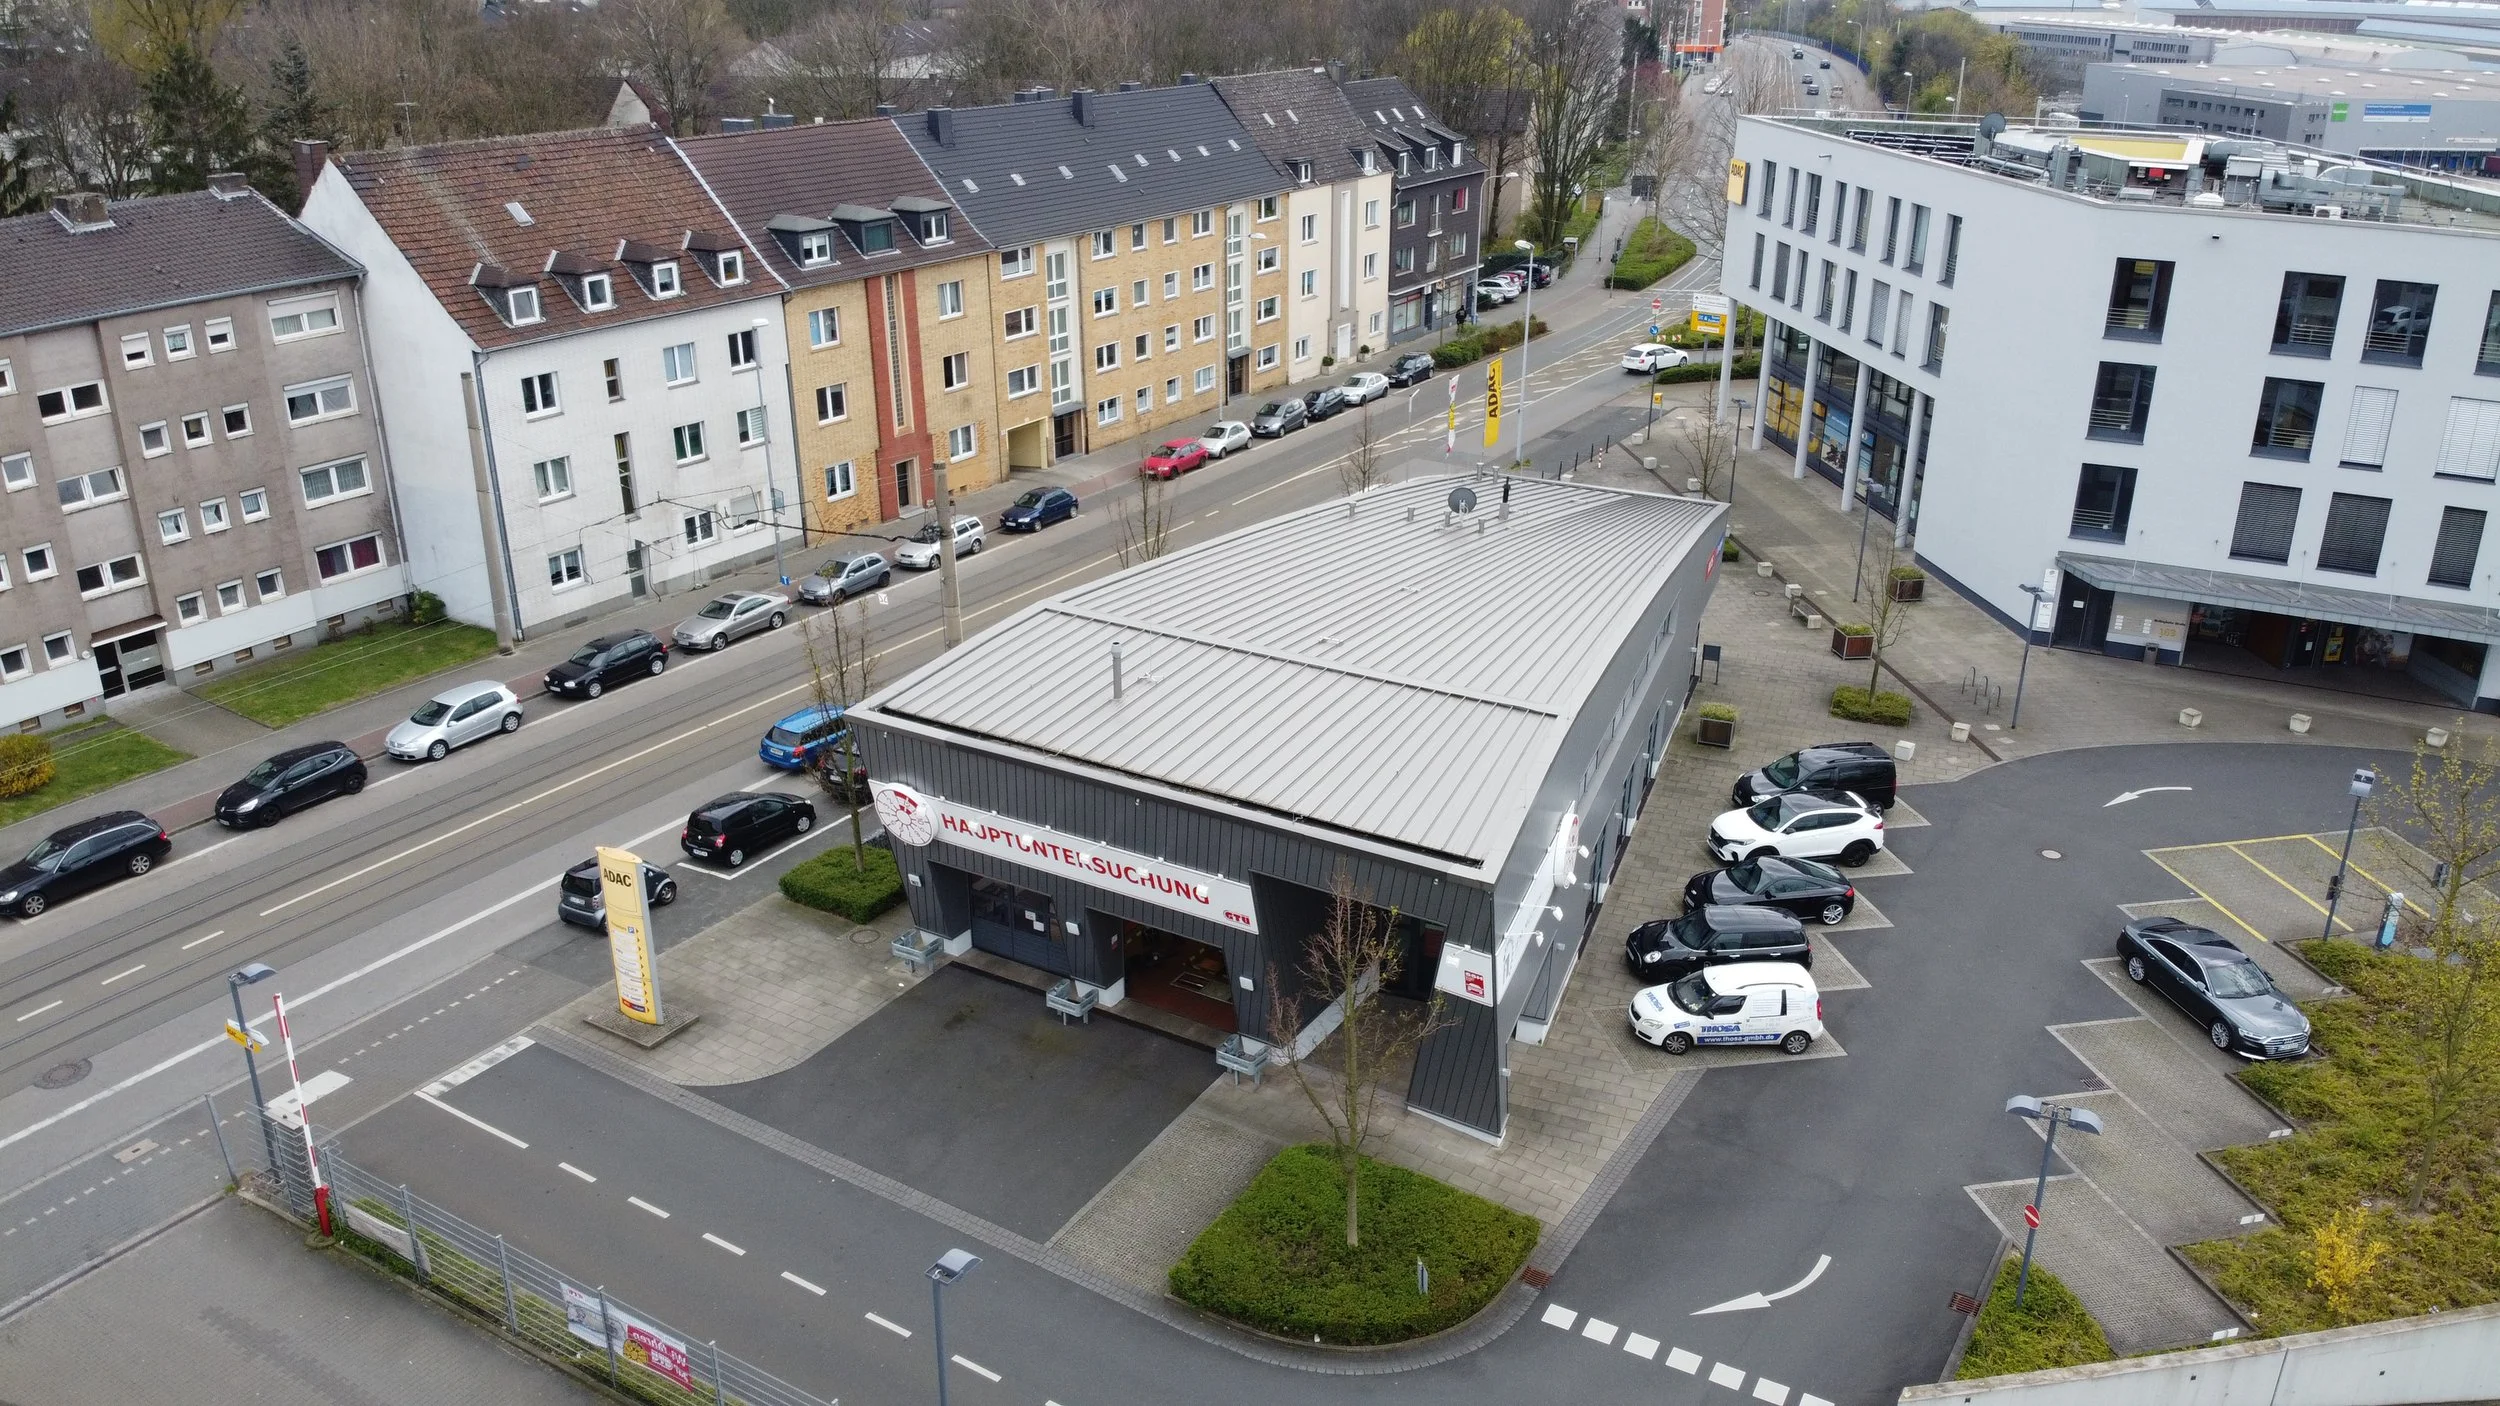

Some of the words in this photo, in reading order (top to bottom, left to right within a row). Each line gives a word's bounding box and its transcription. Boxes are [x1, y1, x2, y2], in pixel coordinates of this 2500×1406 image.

[1730, 162, 1744, 178] ADAC
[1488, 367, 1499, 418] ADAC
[603, 868, 632, 888] ADAC
[1701, 1024, 1741, 1033] THOSA
[1704, 1034, 1775, 1043] www.thosa-gmbh.de
